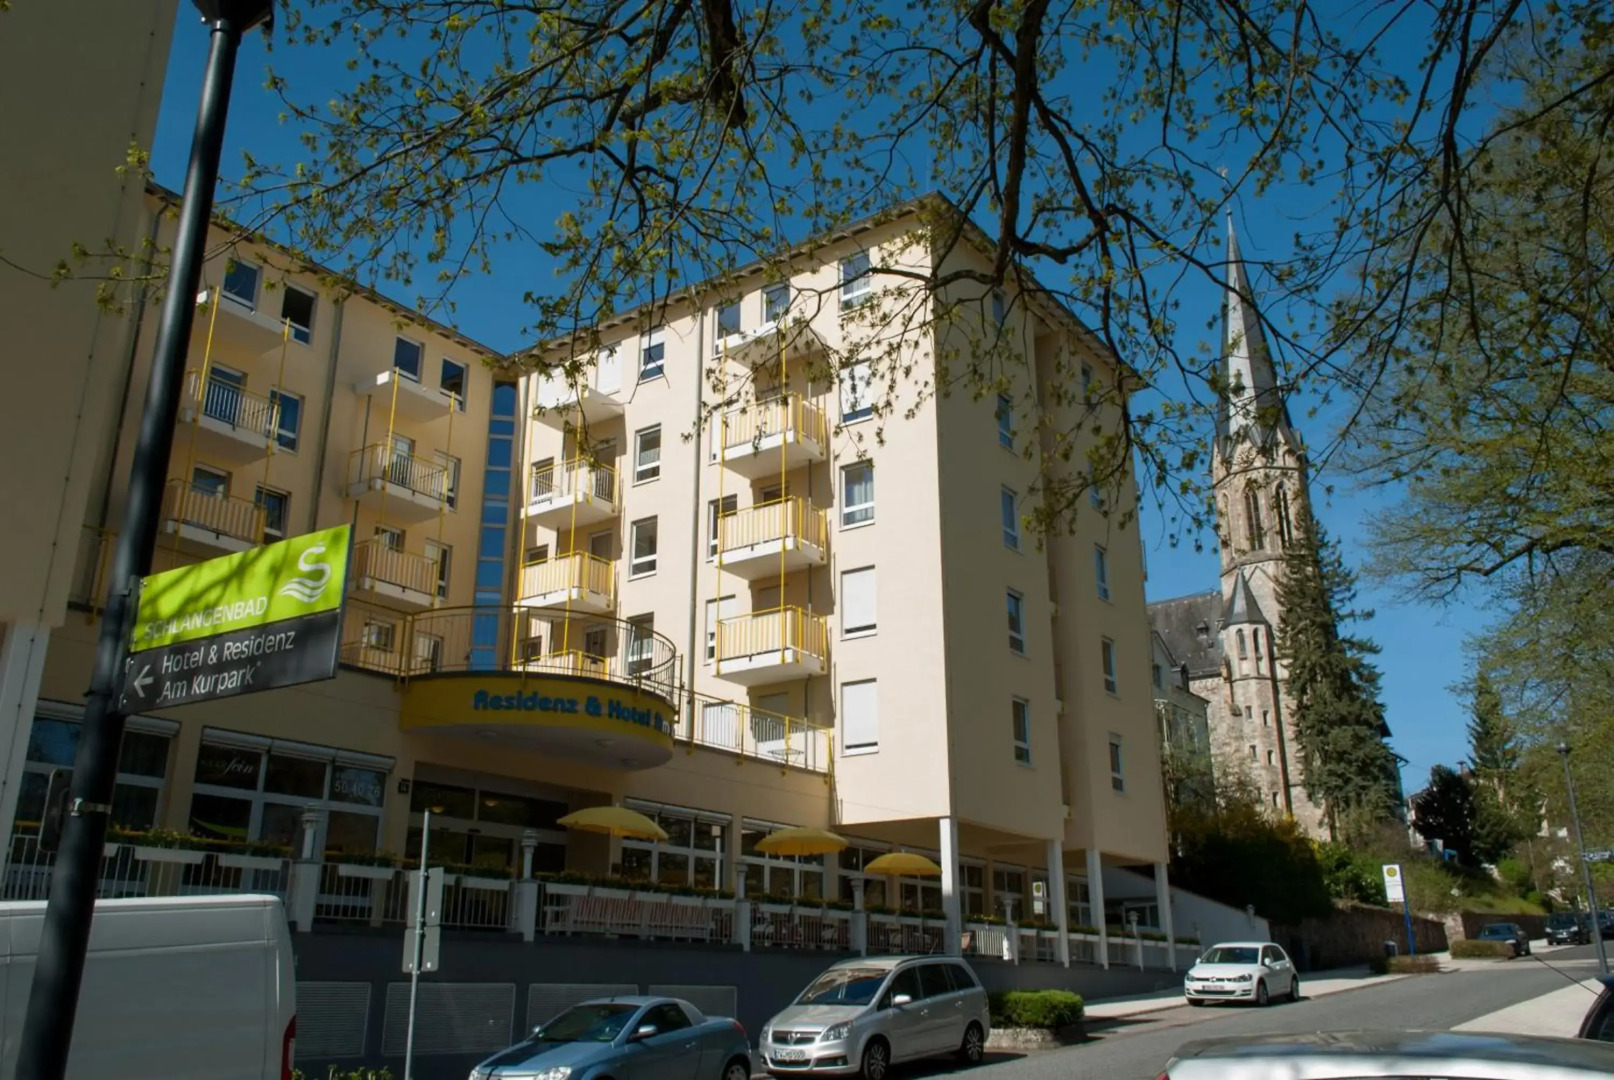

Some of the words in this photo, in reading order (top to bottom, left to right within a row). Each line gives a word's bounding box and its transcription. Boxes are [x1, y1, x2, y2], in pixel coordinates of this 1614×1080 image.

[145, 596, 268, 640] SCHLANGENBAD
[162, 646, 205, 674] Hotel
[207, 644, 219, 665] &
[222, 629, 296, 662] Residenz
[473, 689, 579, 715] Residenz
[585, 696, 602, 717] &
[608, 698, 652, 728] Hotel
